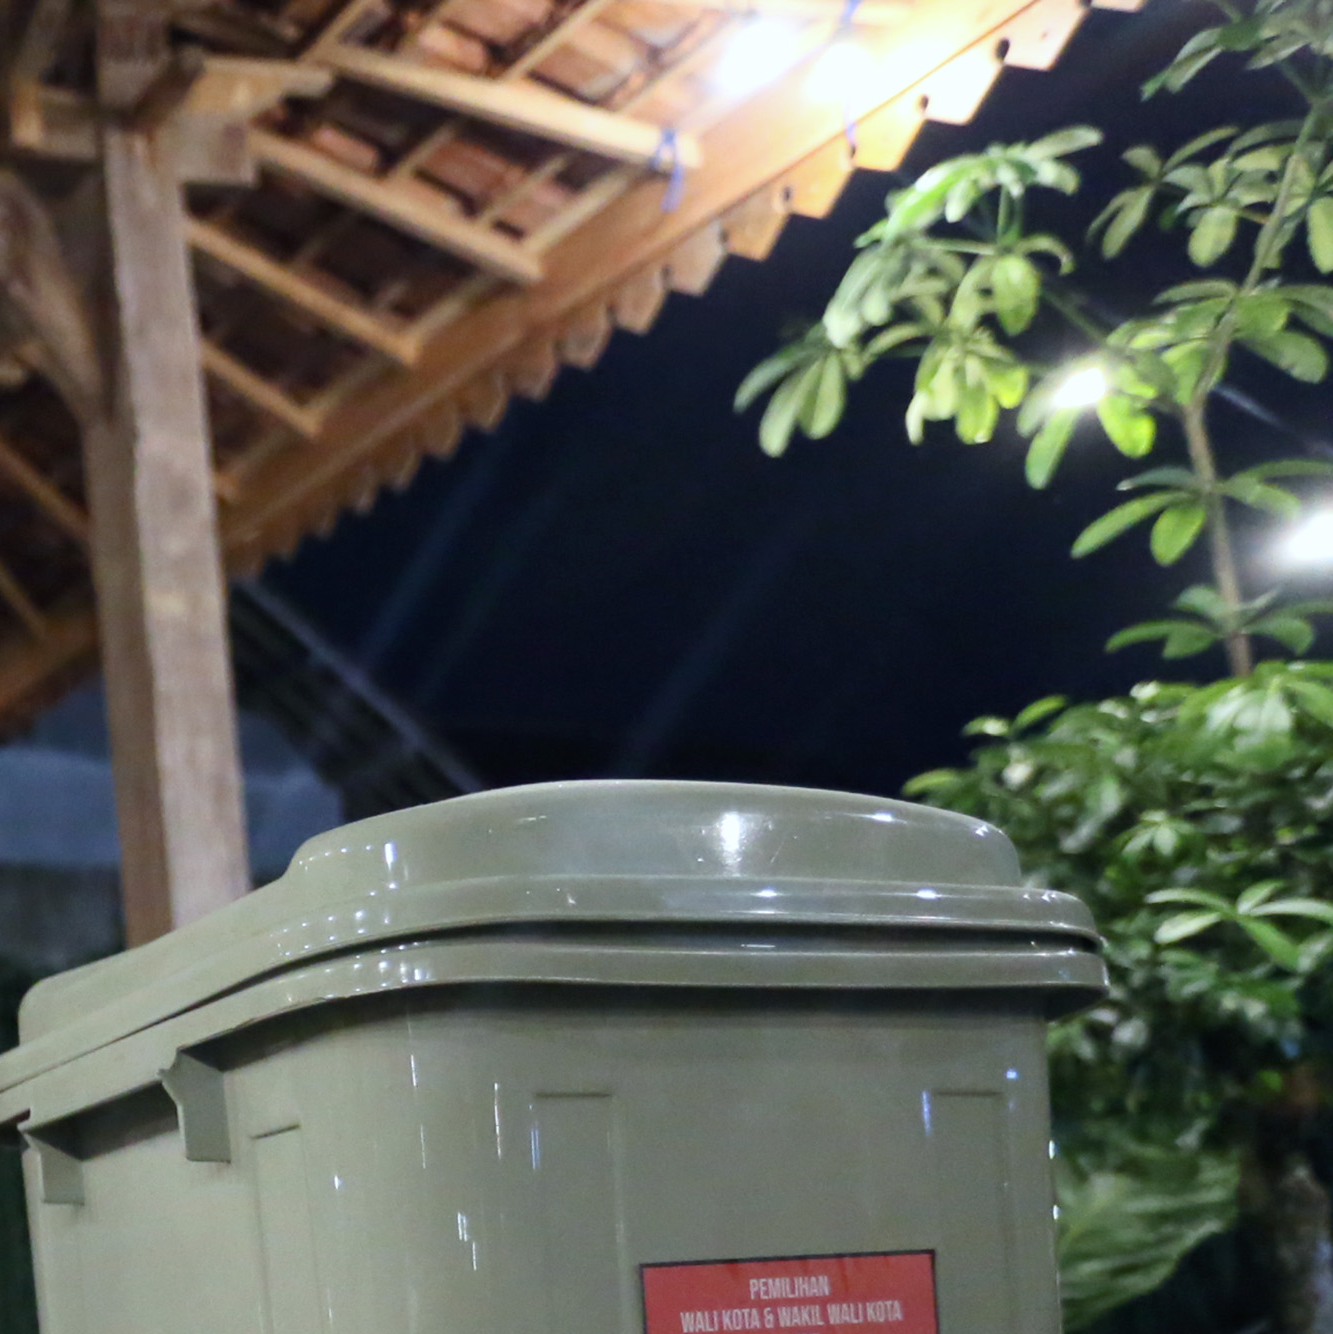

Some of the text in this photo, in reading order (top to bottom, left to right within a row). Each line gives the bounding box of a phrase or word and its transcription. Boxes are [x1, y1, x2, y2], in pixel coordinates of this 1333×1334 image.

[749, 1274, 831, 1300] PEMILIHAN
[680, 1300, 904, 1334] WALI KOTA & WAKIL WALI KOTA
